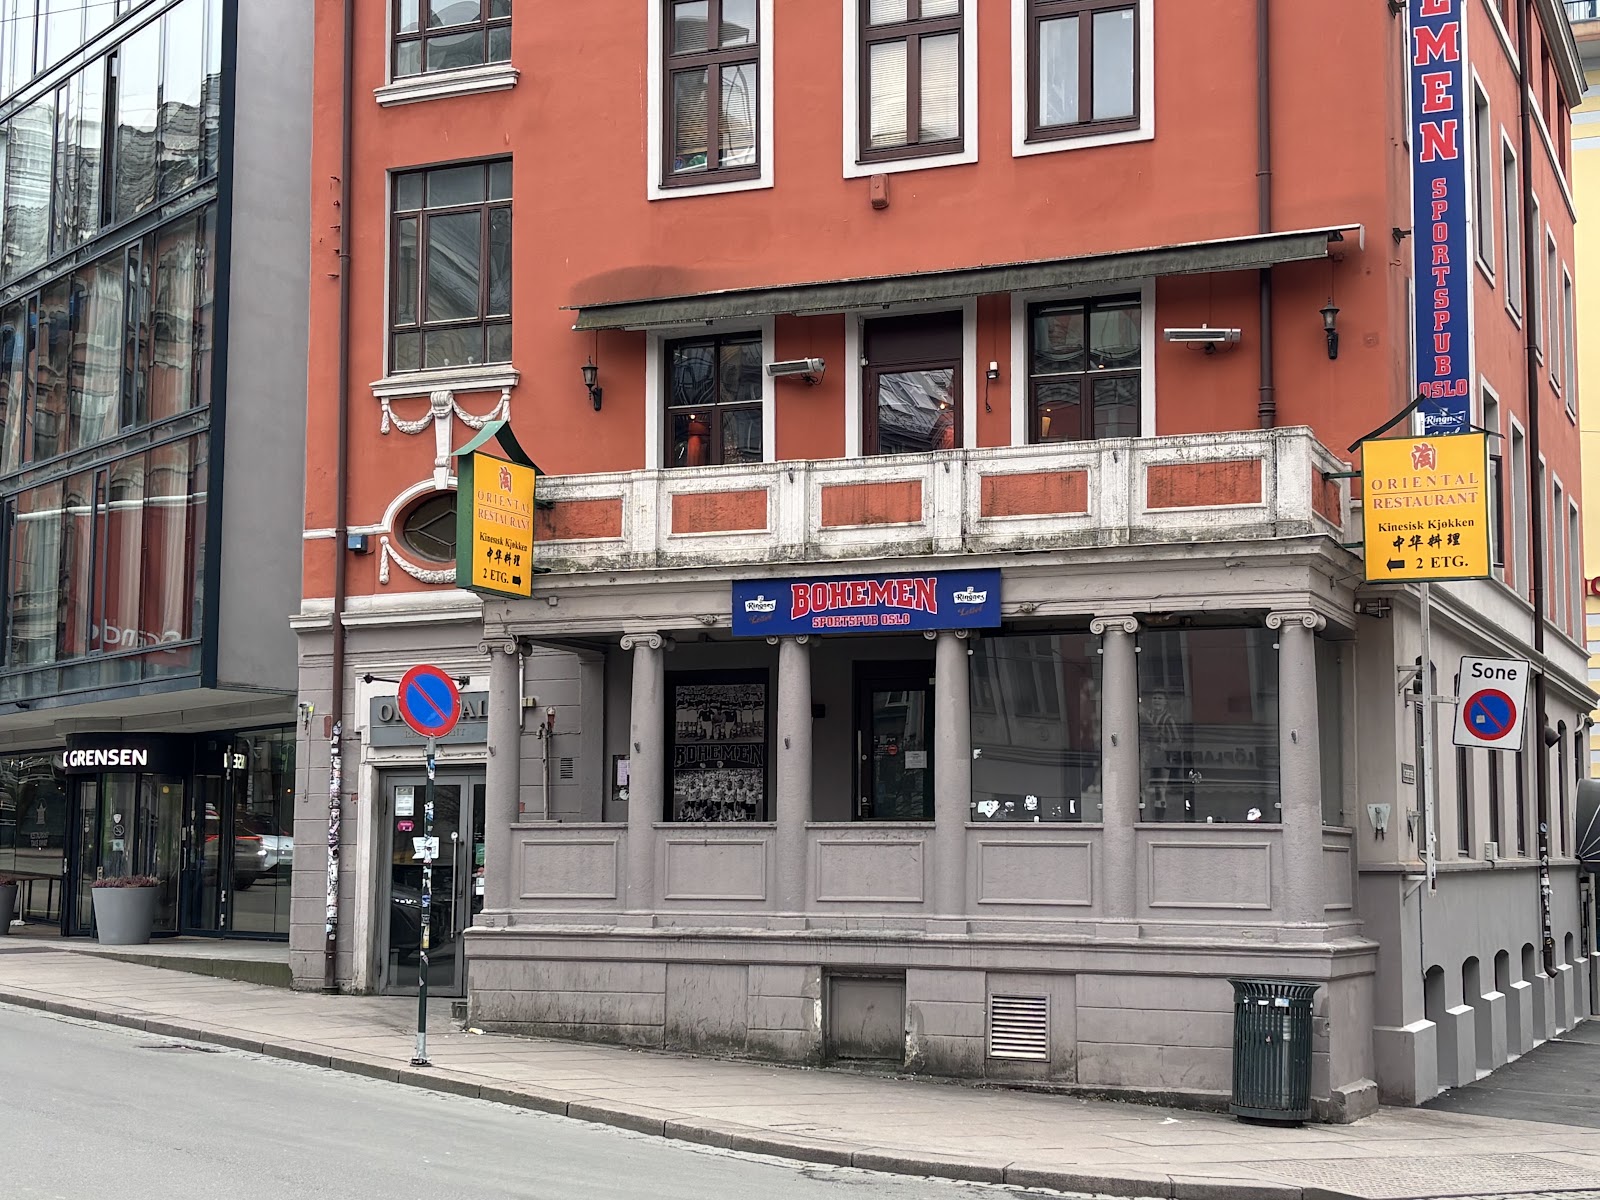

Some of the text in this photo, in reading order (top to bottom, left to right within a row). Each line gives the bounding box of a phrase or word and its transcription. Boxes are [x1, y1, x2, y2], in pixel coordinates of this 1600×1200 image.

[1432, 178, 1451, 376] SPORTSPUB
[1419, 379, 1468, 399] OSLO
[1371, 472, 1479, 491] ORIENTAL
[477, 490, 531, 514] ORIENTAL
[1373, 492, 1479, 510] RESTAURANT
[478, 508, 531, 531] RESTAURANT
[1378, 518, 1475, 532] Kinesisk Kjøkken
[479, 531, 504, 546] Kinesisk
[1415, 555, 1469, 569] 2 ETG.
[482, 567, 509, 584] 2 ETG.
[790, 577, 938, 621] BOHEMEN
[955, 593, 985, 602] Ringnes
[812, 613, 910, 629] SPORTSPUB OSLO
[1471, 662, 1517, 681] Sone
[69, 748, 147, 767] GRENSEN
[673, 744, 764, 768] BOHEMEN
